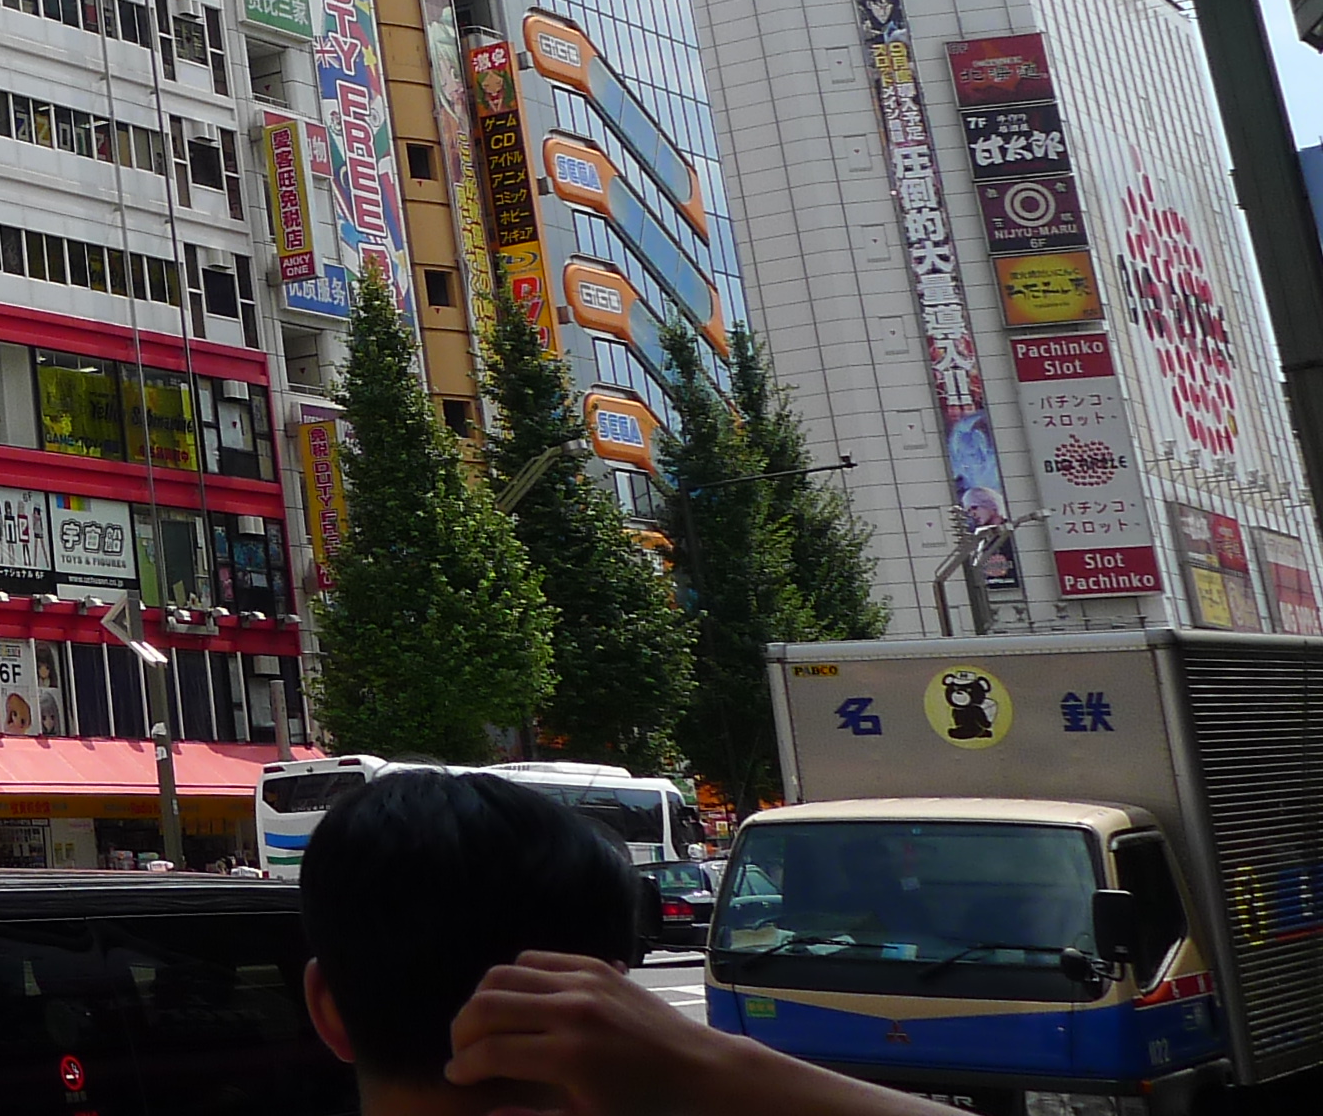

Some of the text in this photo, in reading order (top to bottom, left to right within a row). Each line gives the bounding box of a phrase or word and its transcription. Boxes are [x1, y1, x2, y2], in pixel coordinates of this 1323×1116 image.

[484, 117, 517, 132] ゲーム
[966, 116, 989, 129] 7F
[490, 132, 516, 150] CD
[969, 130, 1065, 167] 甘太郎
[335, 77, 388, 240] FREE
[488, 150, 524, 170] アイドル
[490, 169, 527, 188] アニメ
[555, 153, 601, 193] SEGA
[494, 188, 528, 206] コミック
[498, 208, 531, 226] ホビー
[282, 253, 312, 268] AKKY
[285, 264, 310, 277] ONE
[1016, 340, 1104, 359] Pachinko
[1044, 360, 1084, 376] Slot
[597, 411, 643, 448] SEGA
[61, 518, 125, 557] 宇宙船
[61, 555, 83, 566] TOYS
[96, 557, 128, 570] FIGURES
[1084, 551, 1125, 569] Slot
[1064, 571, 1156, 593] Pachinko
[0, 662, 23, 685] 6F
[792, 664, 839, 677] PABCO
